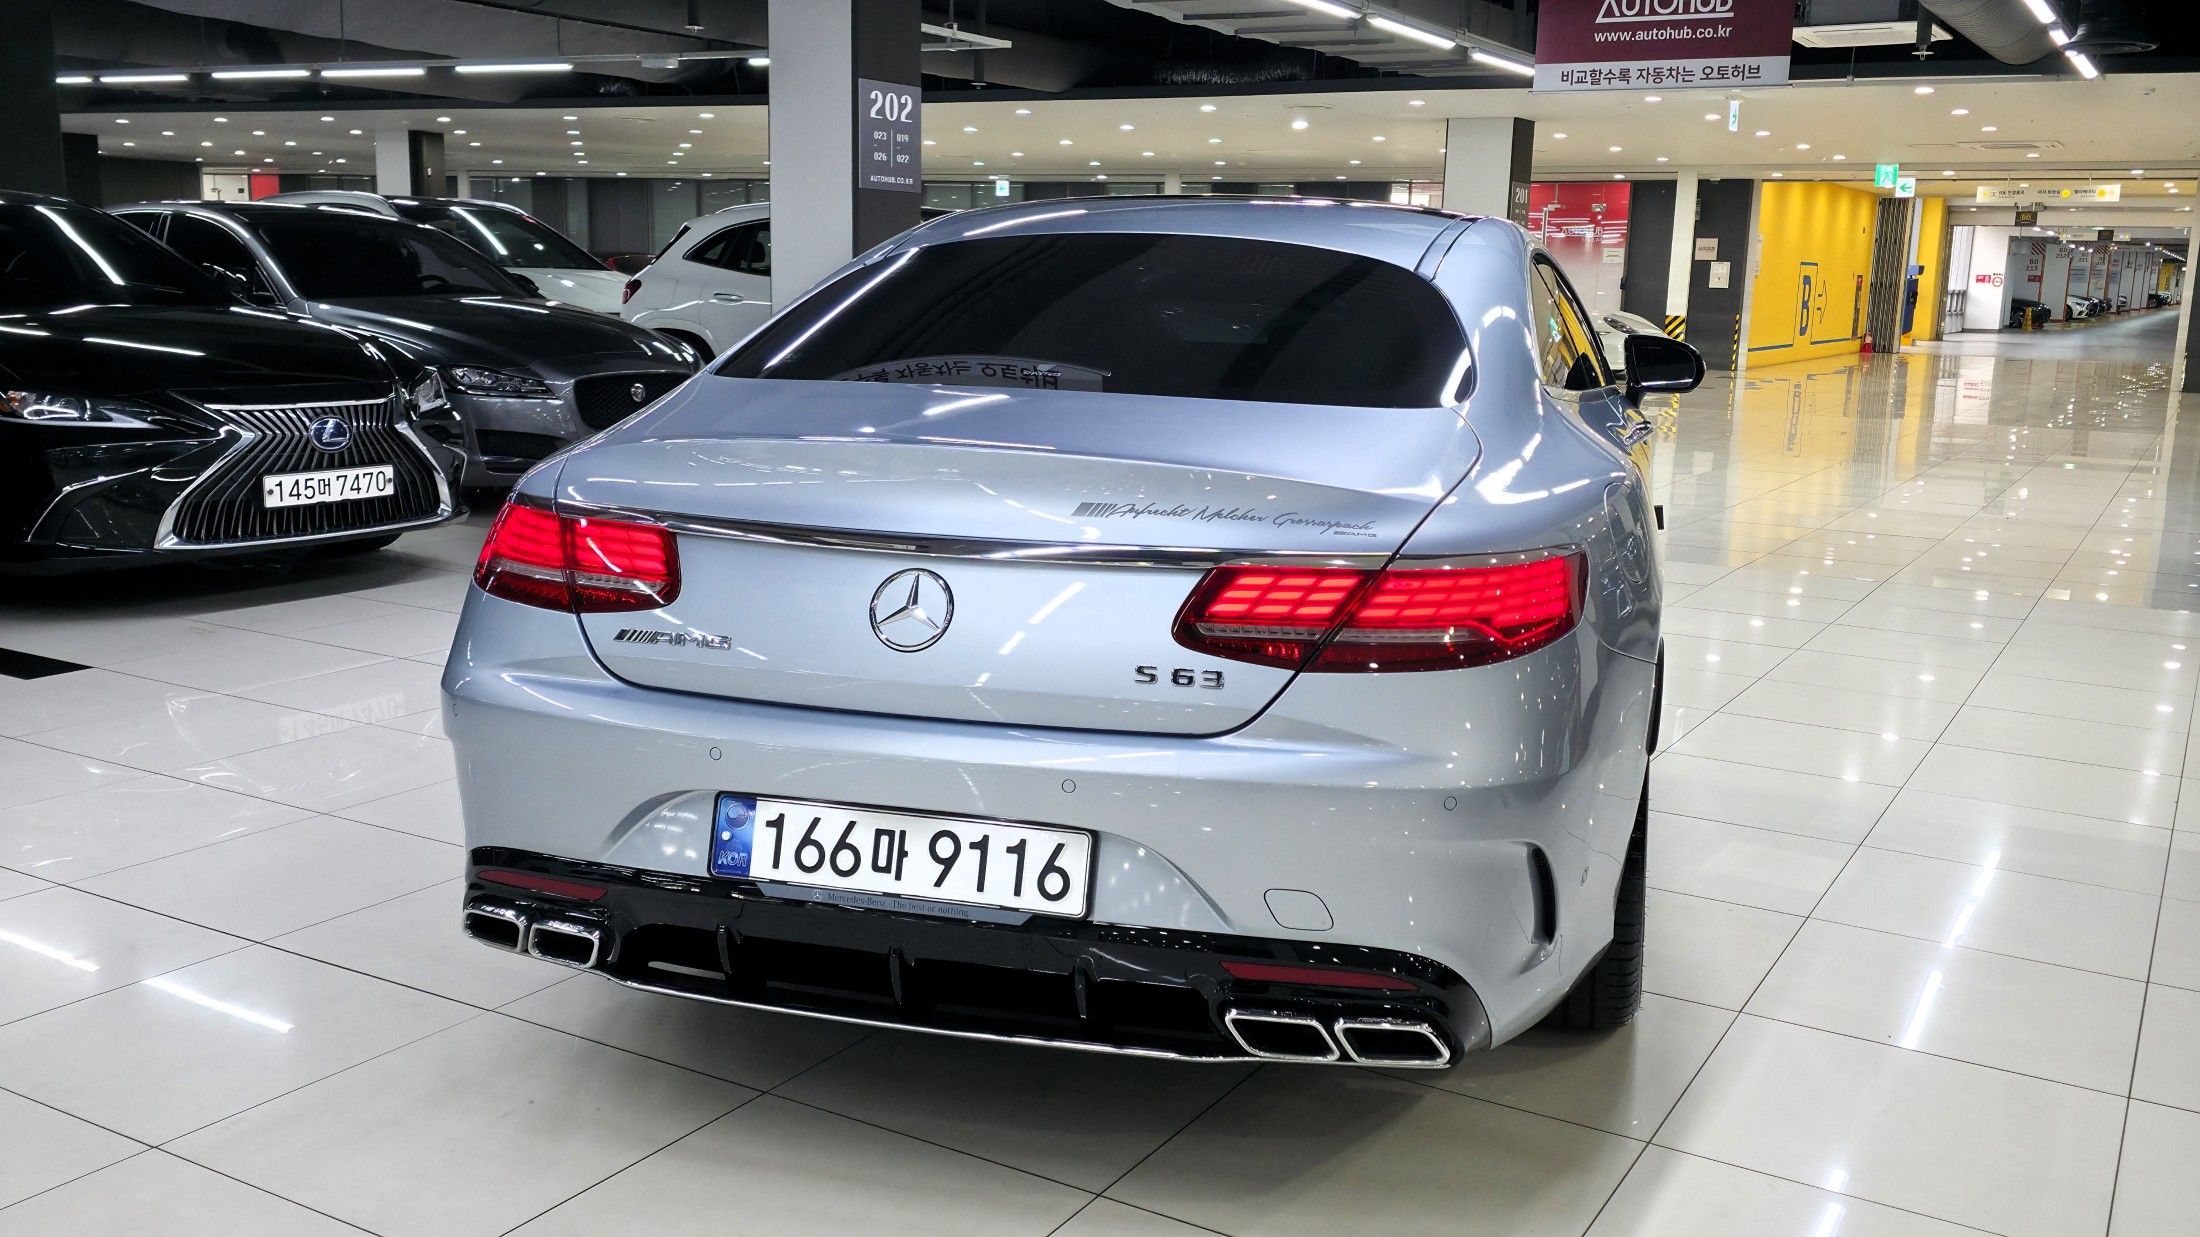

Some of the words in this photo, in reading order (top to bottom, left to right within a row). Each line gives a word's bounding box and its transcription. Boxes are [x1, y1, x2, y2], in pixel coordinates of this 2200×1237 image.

[1594, 25, 1733, 42] www.autohub.co.kr
[1561, 68, 1632, 86] 비교할수록
[1636, 66, 1696, 84] 자동차는
[1699, 64, 1762, 81] 오토허브
[870, 90, 913, 123] 202
[873, 130, 887, 140] 023
[870, 175, 914, 185] AUTOHUB.CO.KR
[1515, 187, 1529, 204] 201
[1799, 275, 1811, 337] B
[275, 478, 331, 502] 145머
[336, 470, 386, 496] 7470
[655, 631, 732, 650] AMG
[1134, 665, 1158, 684] S
[1171, 668, 1225, 690] 63
[717, 850, 748, 867] KOR
[765, 812, 909, 882] 166마
[928, 829, 1071, 902] 9116
[893, 900, 907, 909] The
[908, 902, 925, 912] best
